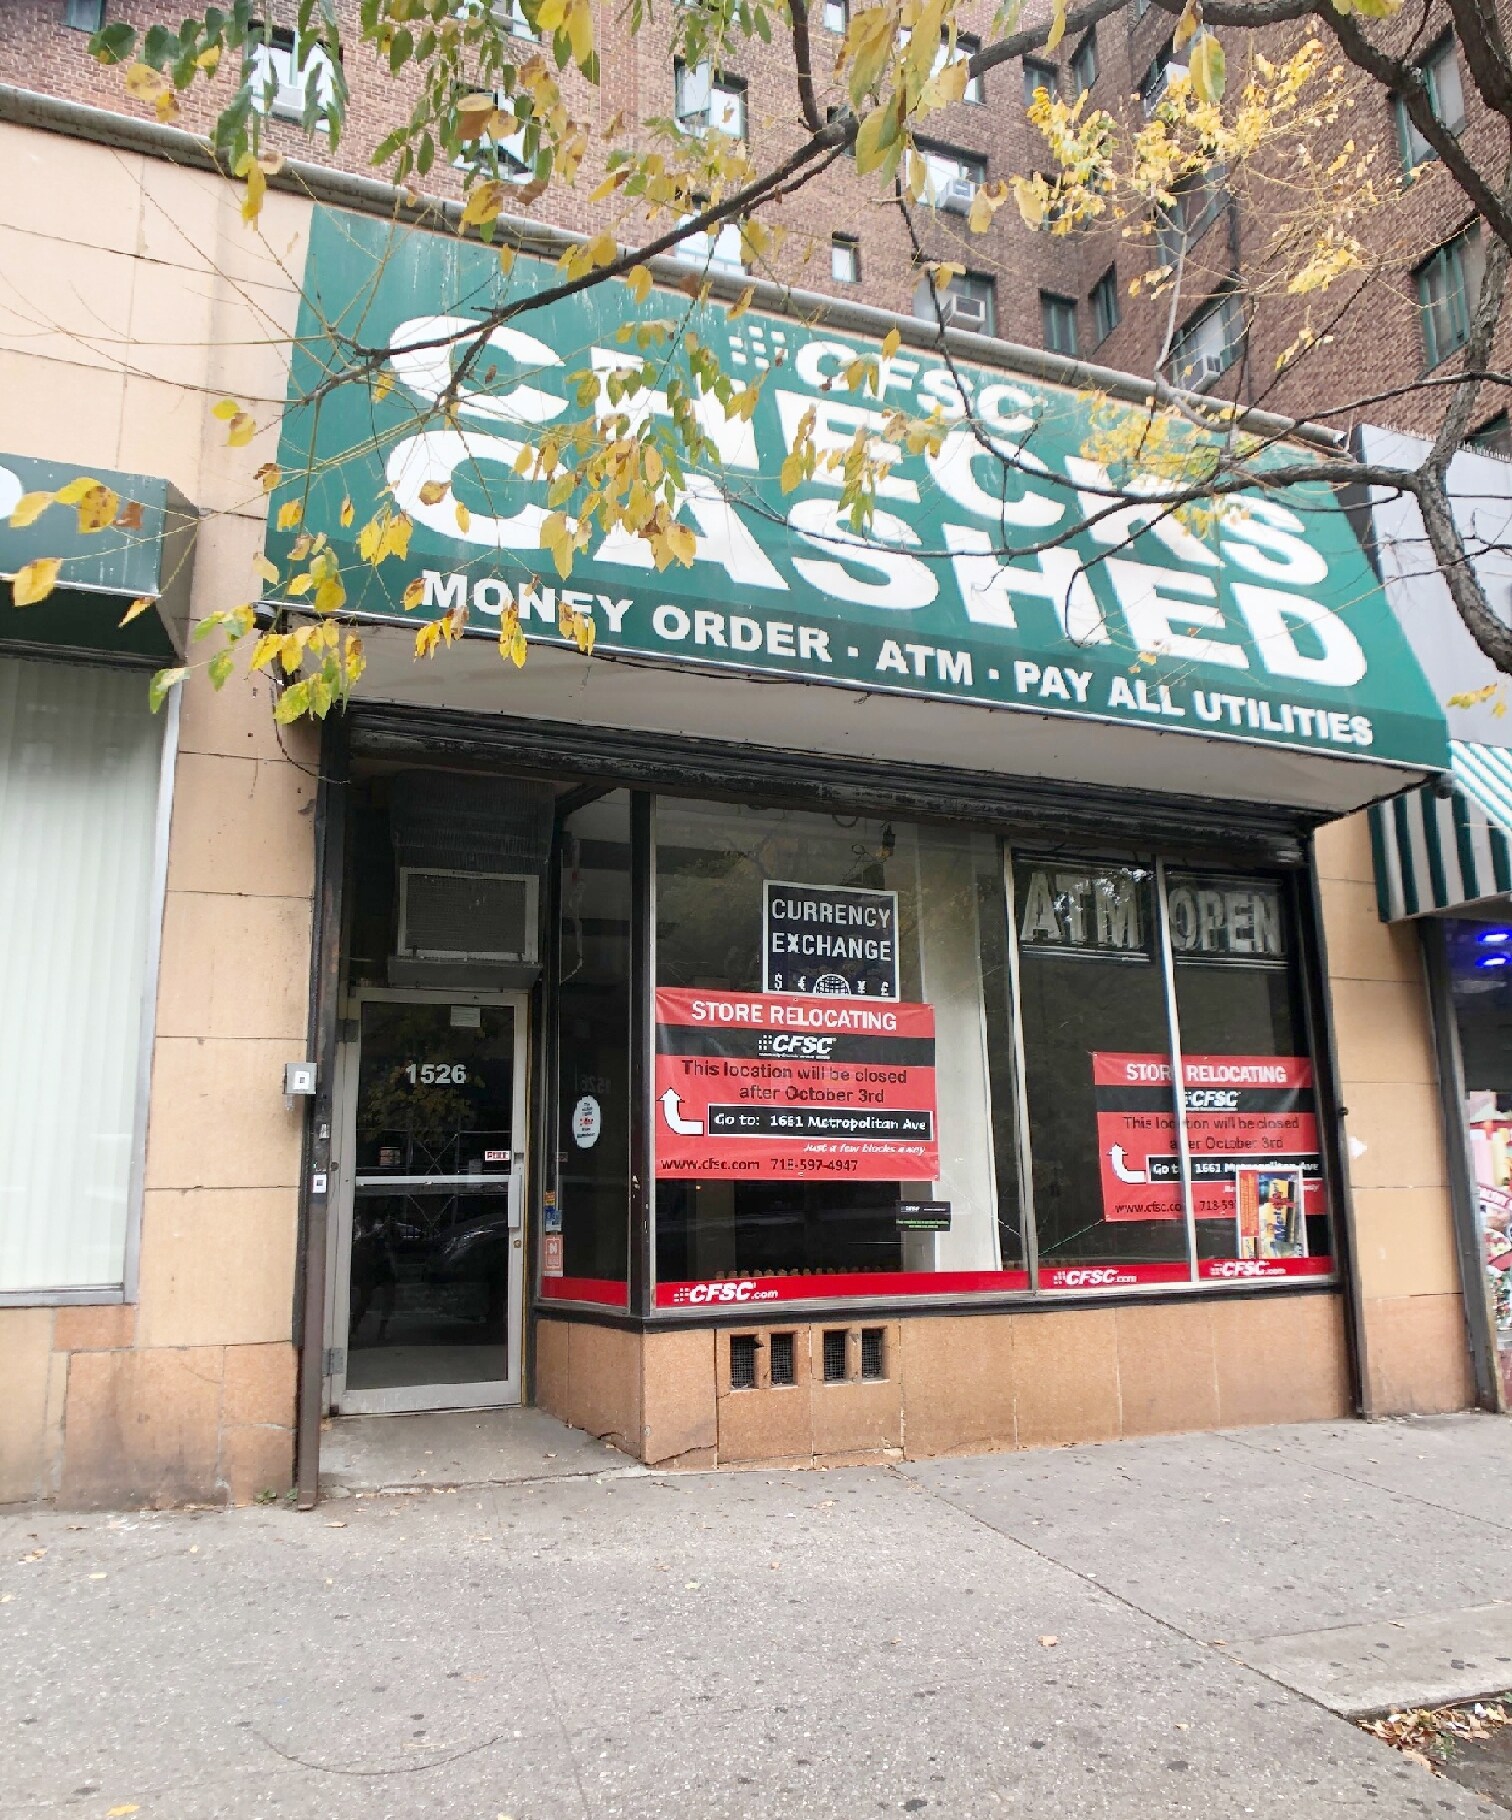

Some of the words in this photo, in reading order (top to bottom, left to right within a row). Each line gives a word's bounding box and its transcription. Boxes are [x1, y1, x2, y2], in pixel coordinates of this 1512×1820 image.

[795, 341, 1037, 432] CFSC
[389, 316, 1328, 585] CHECKS
[386, 430, 1366, 686] CASHED
[652, 605, 831, 662] ORDER
[875, 640, 974, 686] ATM
[1014, 661, 1093, 703] PAY
[1107, 677, 1186, 717] ALL
[1194, 690, 1374, 747] UTILITIES
[771, 898, 892, 929] CURRENCY
[1020, 872, 1146, 949] ATM
[1168, 886, 1283, 956] OPEN
[772, 932, 892, 962] EXCHANGE
[691, 1000, 763, 1024] STORE
[770, 1005, 897, 1031] RELOCATING
[772, 1034, 833, 1054] CFSC
[405, 1062, 468, 1085] 1526
[681, 1059, 720, 1076] This
[723, 1061, 793, 1079] location
[797, 1064, 826, 1081] will
[829, 1066, 850, 1082] be
[855, 1068, 907, 1084] closed
[1126, 1063, 1173, 1081] STOR
[1186, 1064, 1287, 1083] RELOCATING
[739, 1085, 781, 1101] after
[785, 1086, 853, 1102] October
[858, 1087, 884, 1104] 3rd
[1192, 1090, 1239, 1107] CFSC
[714, 1112, 735, 1126] Go
[739, 1114, 760, 1127] to:
[807, 1116, 899, 1131] Metropolitan
[903, 1118, 926, 1132] Ave
[1124, 1116, 1152, 1129] This
[1214, 1116, 1236, 1129] will
[1239, 1116, 1255, 1129] be
[1256, 1116, 1300, 1129] closed
[1205, 1136, 1258, 1149] October
[1261, 1136, 1284, 1149] 3rd
[1152, 1163, 1170, 1176] Go
[689, 1282, 779, 1303] CFSC.com
